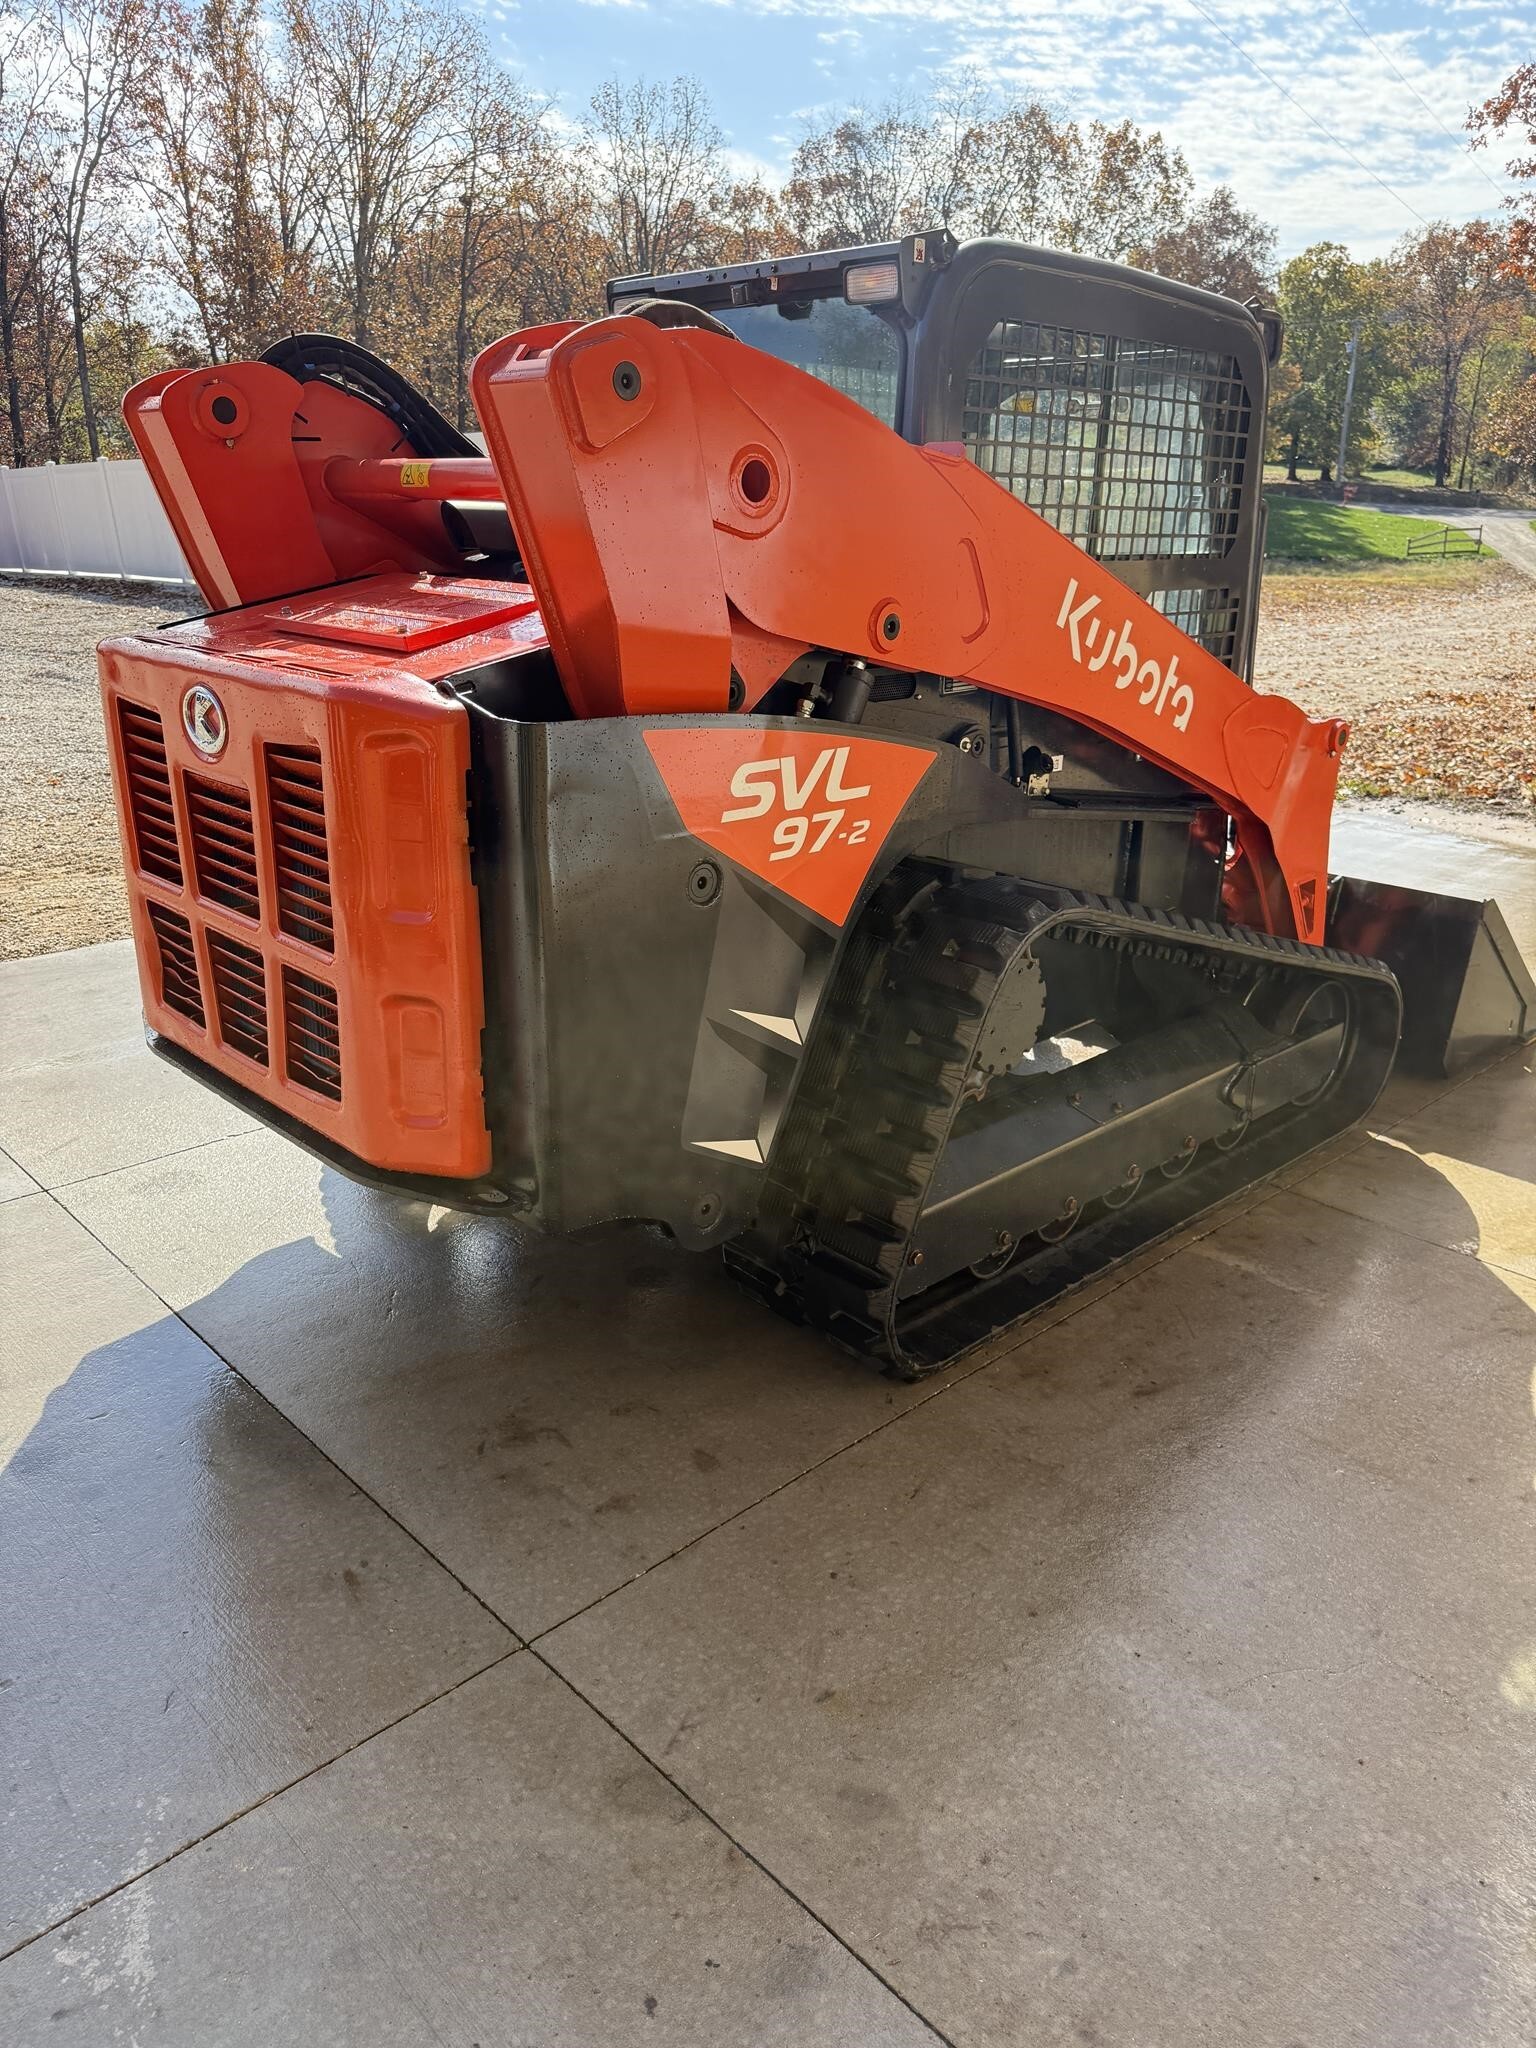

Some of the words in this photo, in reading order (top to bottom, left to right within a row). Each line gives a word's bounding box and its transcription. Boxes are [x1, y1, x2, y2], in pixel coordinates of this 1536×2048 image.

[1056, 577, 1194, 733] Kubota
[720, 746, 871, 824] SVL
[768, 808, 871, 862] 97-2
